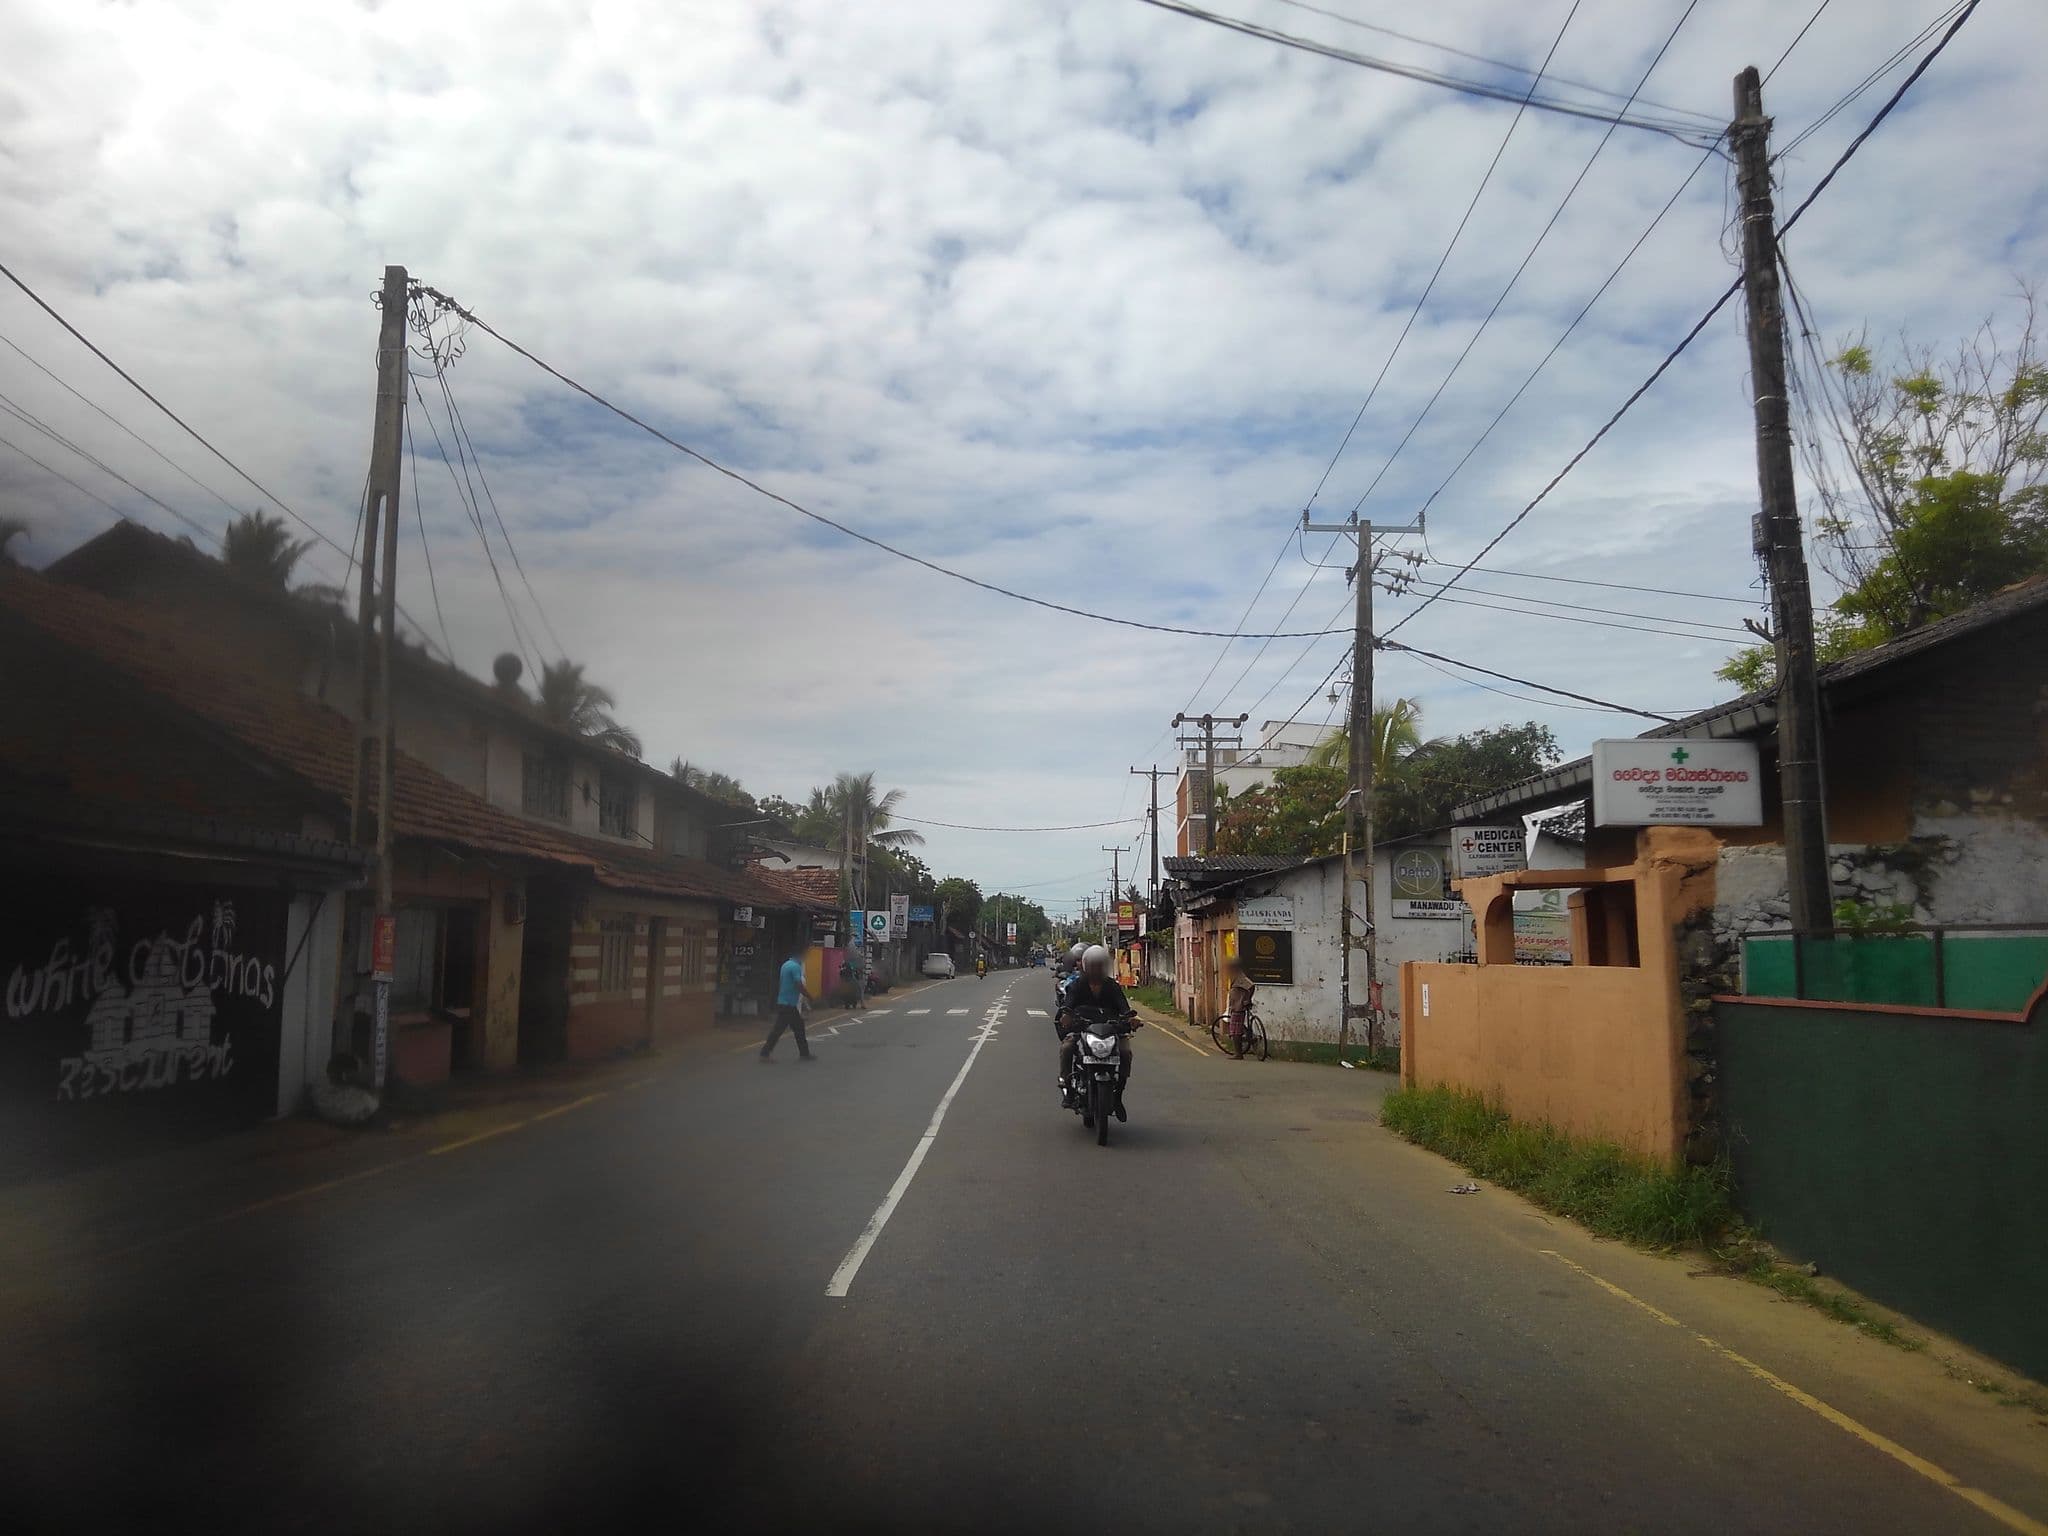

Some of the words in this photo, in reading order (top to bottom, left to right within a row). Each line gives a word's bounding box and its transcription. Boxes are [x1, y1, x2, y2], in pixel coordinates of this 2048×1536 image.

[1474, 830, 1524, 840] MEDICAL
[1478, 842, 1522, 853] CENTER
[1398, 865, 1434, 878] Dettol
[1409, 901, 1454, 910] MANAWADU
